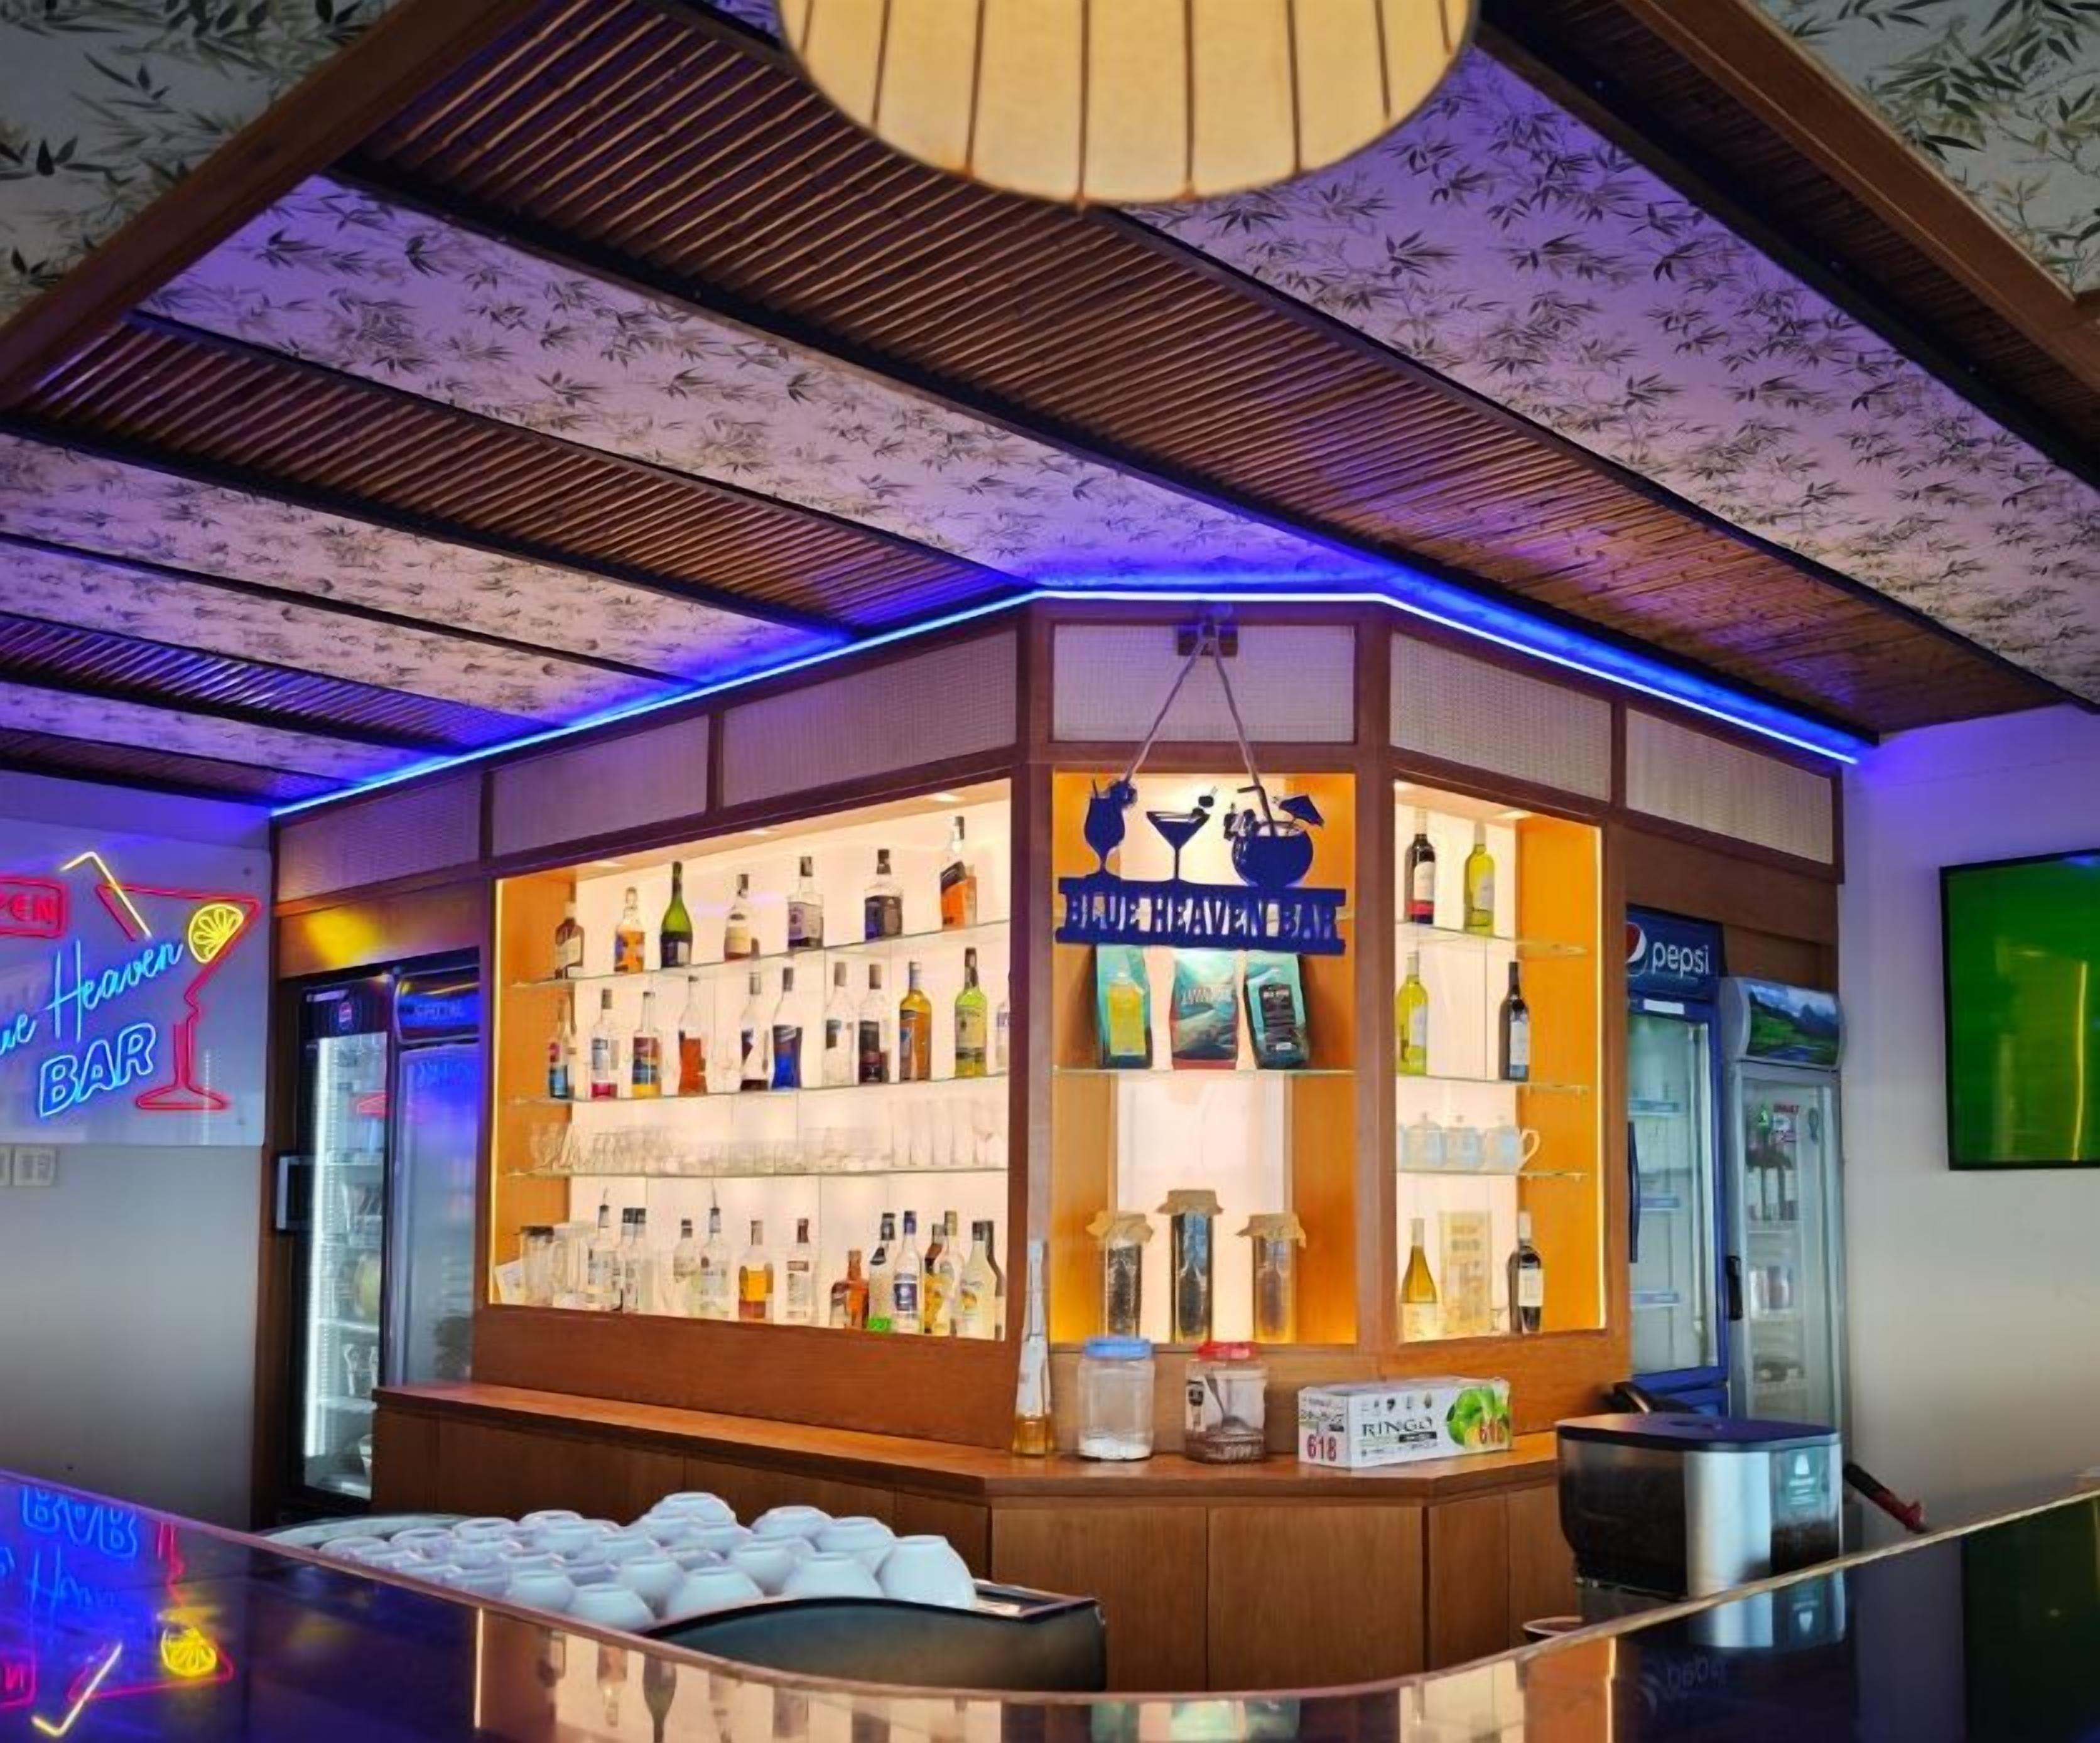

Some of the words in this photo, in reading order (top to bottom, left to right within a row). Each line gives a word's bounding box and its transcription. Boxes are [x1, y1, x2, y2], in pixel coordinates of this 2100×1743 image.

[1065, 893, 1139, 932] BLUE
[1152, 896, 1267, 936] HEAVEN
[1279, 902, 1336, 939] BAR
[1651, 941, 1710, 979] pepsi
[41, 938, 184, 1044] Heaven
[40, 1022, 156, 1118] BAR
[1306, 1433, 1338, 1462] 618
